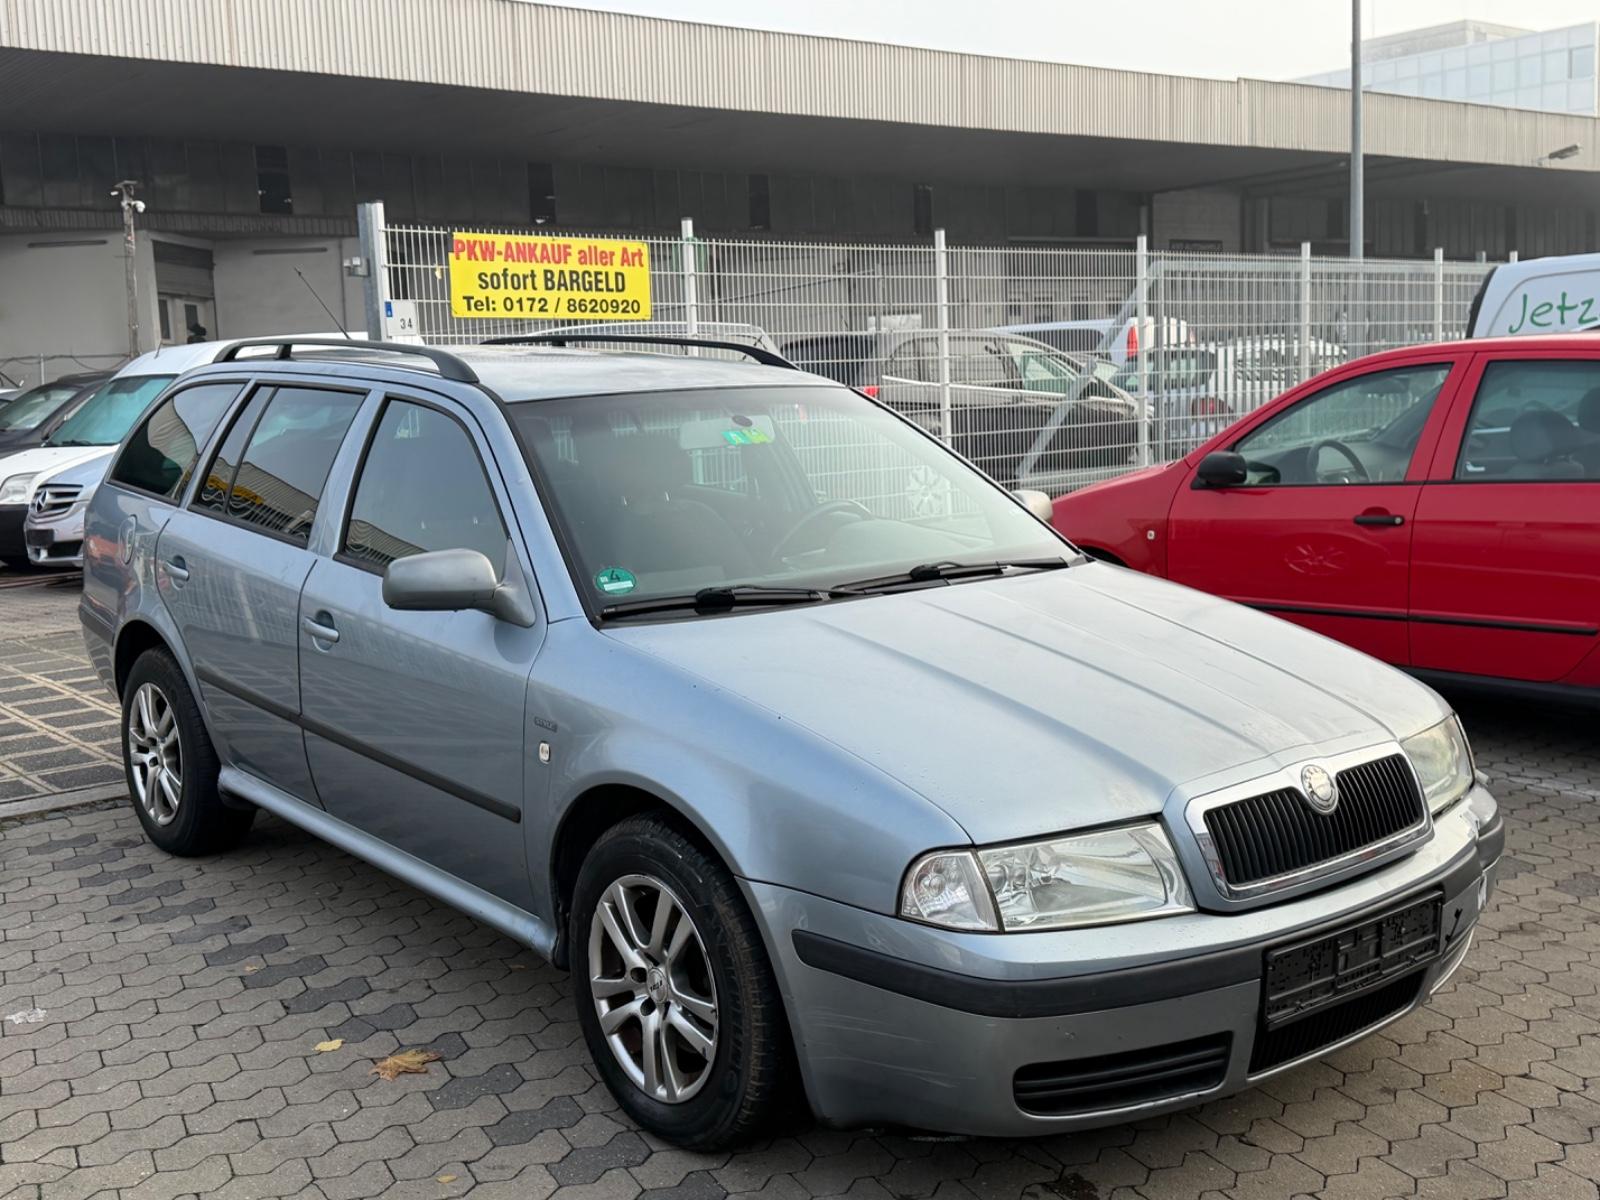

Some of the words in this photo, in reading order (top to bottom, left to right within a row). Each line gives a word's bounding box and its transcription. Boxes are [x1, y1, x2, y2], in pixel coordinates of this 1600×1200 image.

[453, 239, 572, 264] PKW-ANKAUF
[578, 247, 615, 266] aller
[620, 247, 644, 267] Art
[478, 268, 537, 291] sofort
[543, 269, 625, 292] BARGELD
[463, 296, 497, 312] Tel:
[503, 297, 548, 313] 0172
[554, 297, 560, 313] /
[567, 298, 640, 314] 8620920
[610, 569, 621, 581] 4
